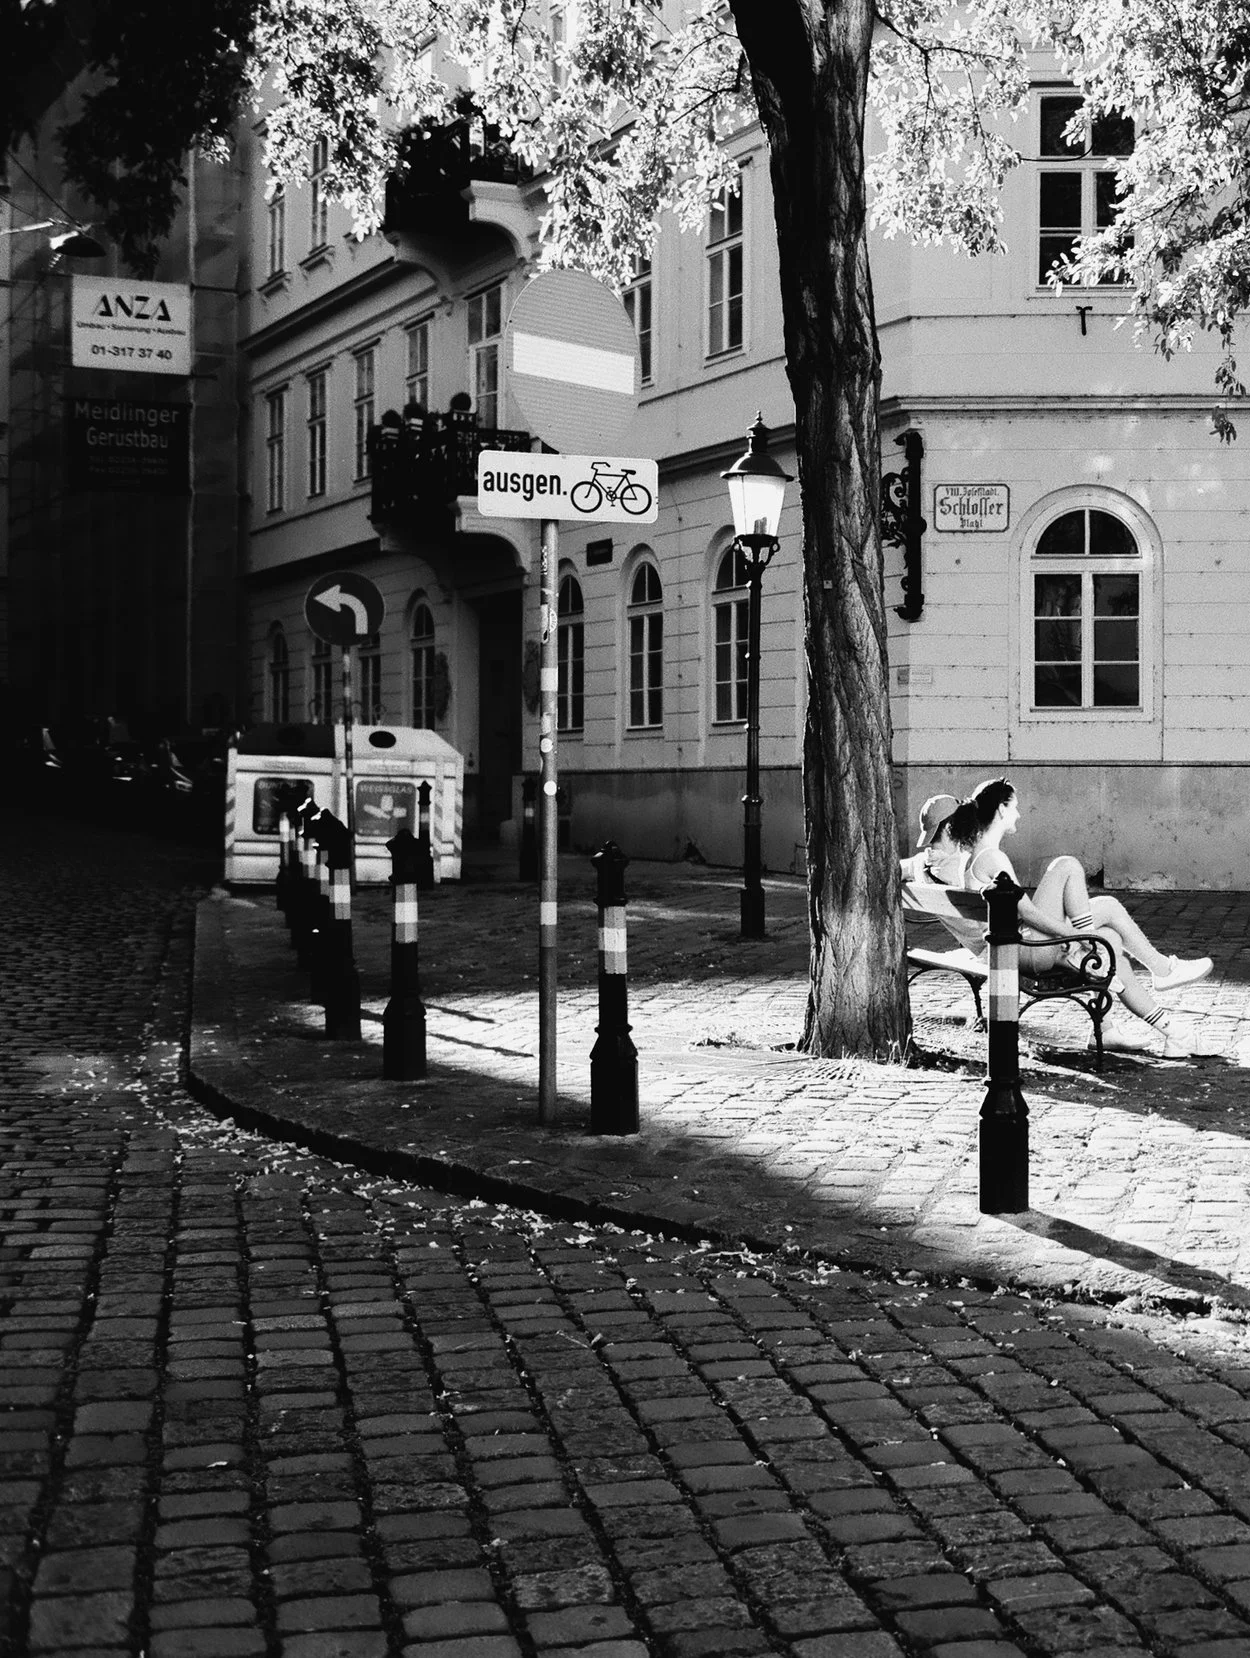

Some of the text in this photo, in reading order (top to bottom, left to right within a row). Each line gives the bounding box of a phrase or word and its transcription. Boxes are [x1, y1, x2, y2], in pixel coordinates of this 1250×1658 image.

[92, 294, 171, 321] ANZA
[138, 347, 153, 359] 37
[156, 349, 172, 360] 40
[73, 401, 180, 427] Meidlinger
[86, 426, 169, 449] Gerüstbau
[483, 470, 568, 502] ausgen.
